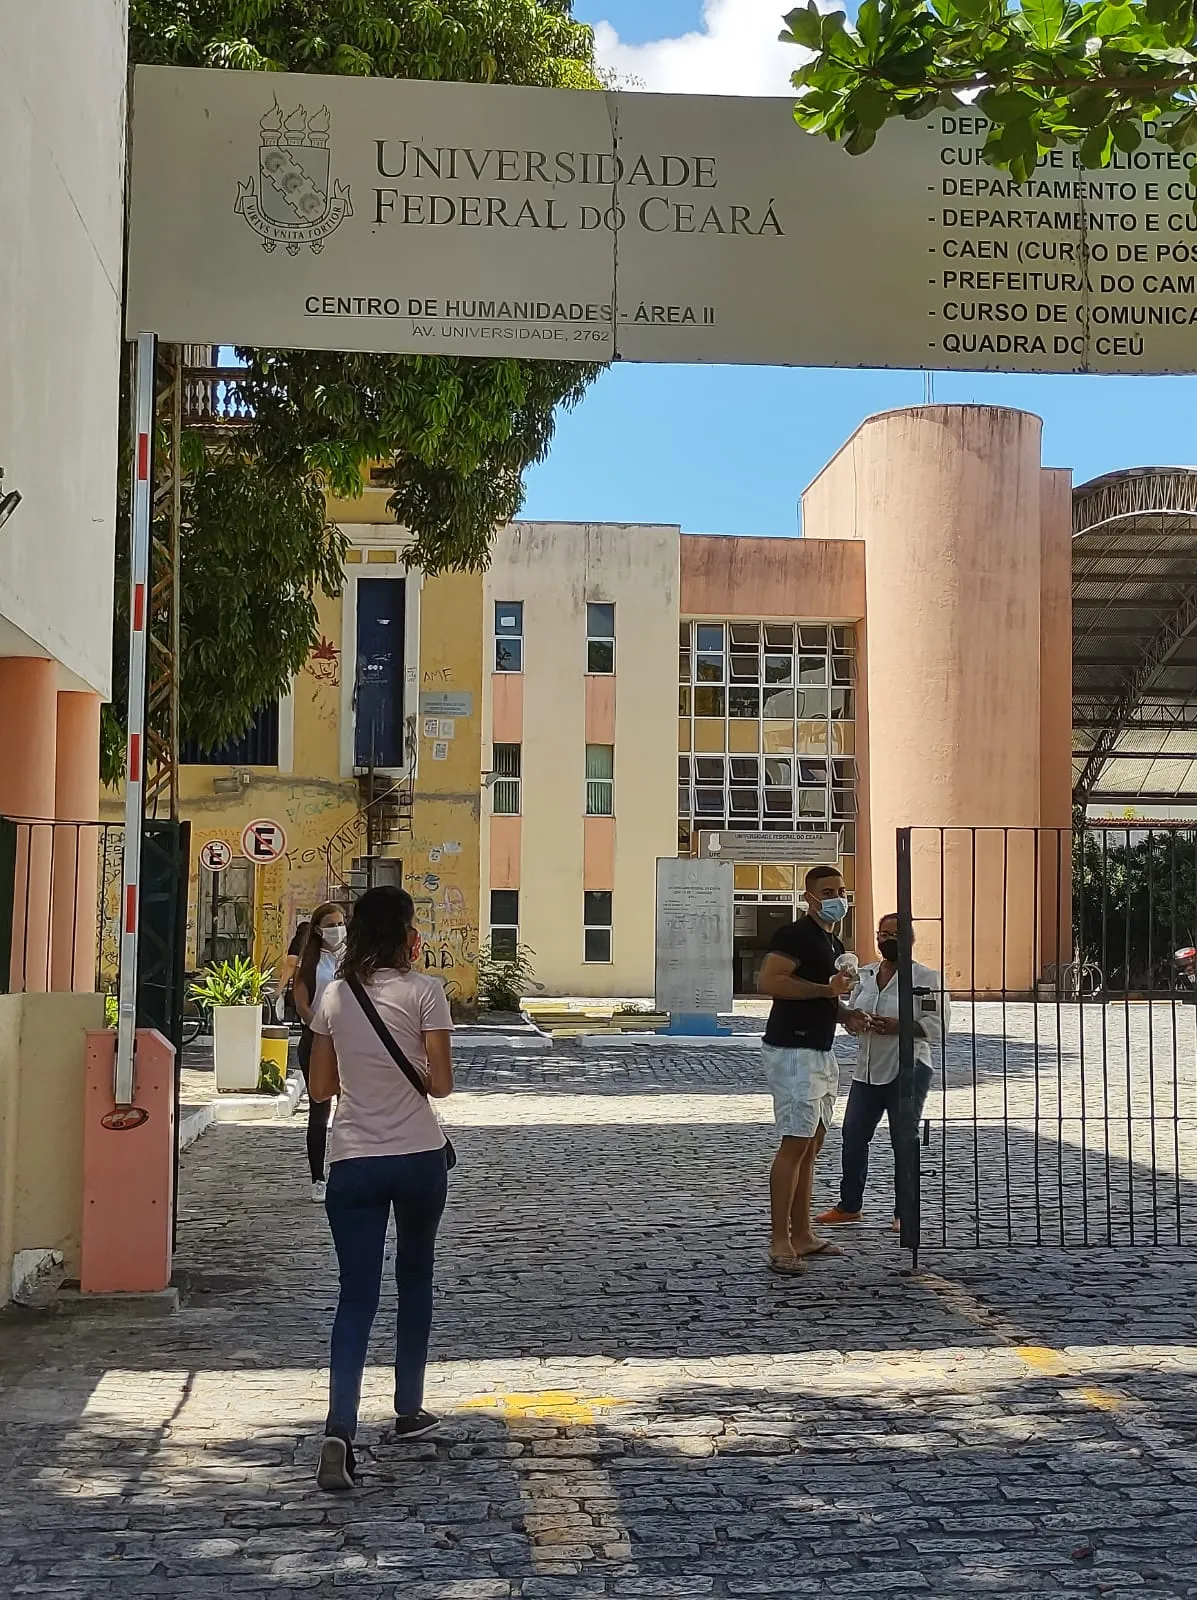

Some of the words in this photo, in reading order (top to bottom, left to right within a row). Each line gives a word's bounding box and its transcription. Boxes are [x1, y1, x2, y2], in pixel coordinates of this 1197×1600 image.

[372, 139, 718, 188] UNIVERSIDADE
[942, 178, 1137, 201] DEPARTAMENTO
[1145, 182, 1159, 200] E
[308, 206, 342, 238] FORTIOR
[371, 188, 568, 229] FEDERAL
[638, 197, 788, 236] CEARÁ
[943, 208, 1137, 231] DEPARTAMENTO
[1145, 213, 1160, 231] E
[942, 240, 1008, 259] CAEN
[1116, 244, 1148, 262] DE
[943, 271, 1094, 293] PREFEITURA
[1100, 274, 1135, 293] DO
[305, 296, 400, 315] CENTRO
[408, 299, 438, 317] DE
[446, 300, 613, 321] HUMANIDADES
[634, 301, 697, 324] ÁREA
[703, 307, 714, 324] II
[943, 303, 1028, 321] CURSO
[1036, 304, 1068, 322] DE
[412, 326, 436, 337] AV.
[441, 326, 569, 342] UNIVERSIDADE,
[573, 330, 609, 342] 2762
[942, 334, 1047, 354] QUADRA
